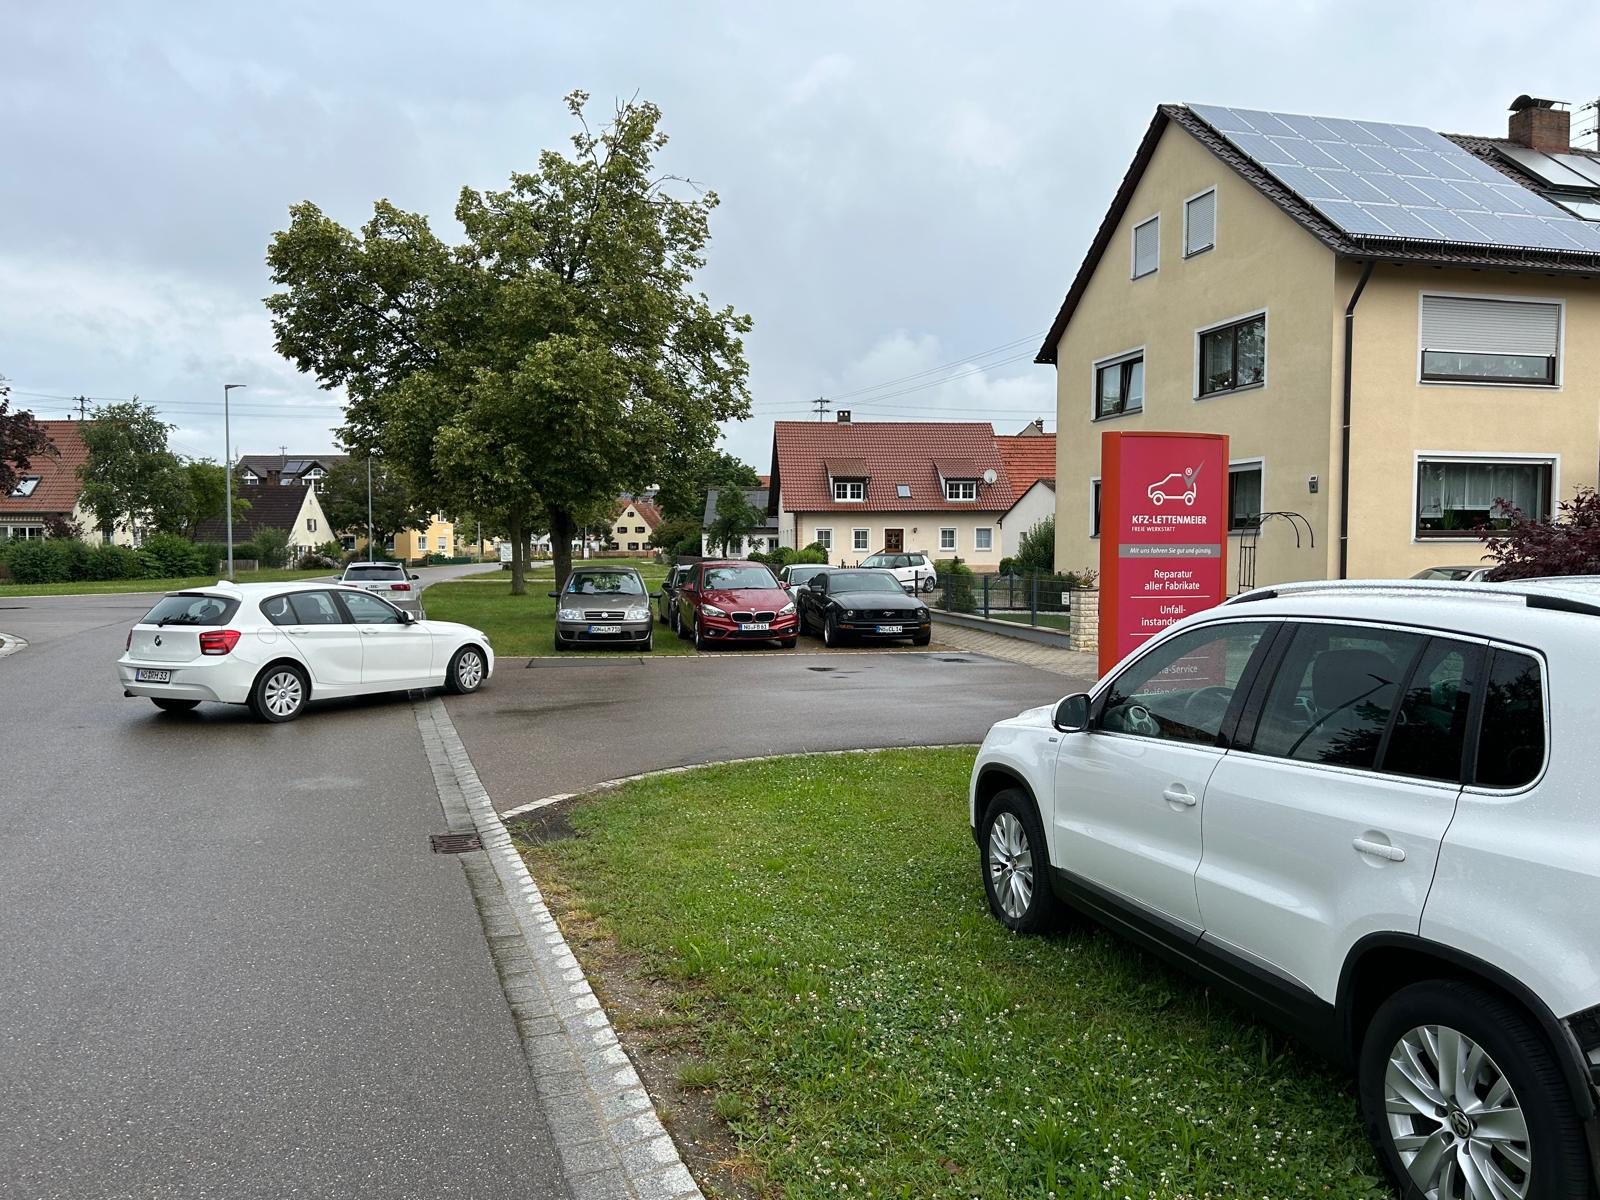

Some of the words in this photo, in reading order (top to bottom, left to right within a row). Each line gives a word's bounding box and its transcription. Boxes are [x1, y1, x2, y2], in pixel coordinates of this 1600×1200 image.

[1132, 515, 1207, 524] KFZ-LETTENMEIER
[1150, 547, 1167, 555] fahren
[1177, 547, 1185, 555] gut
[1154, 569, 1192, 580] Reparatur
[1144, 581, 1163, 590] aller
[1165, 581, 1200, 590] Fabrikate
[1160, 605, 1186, 614] Unfall-
